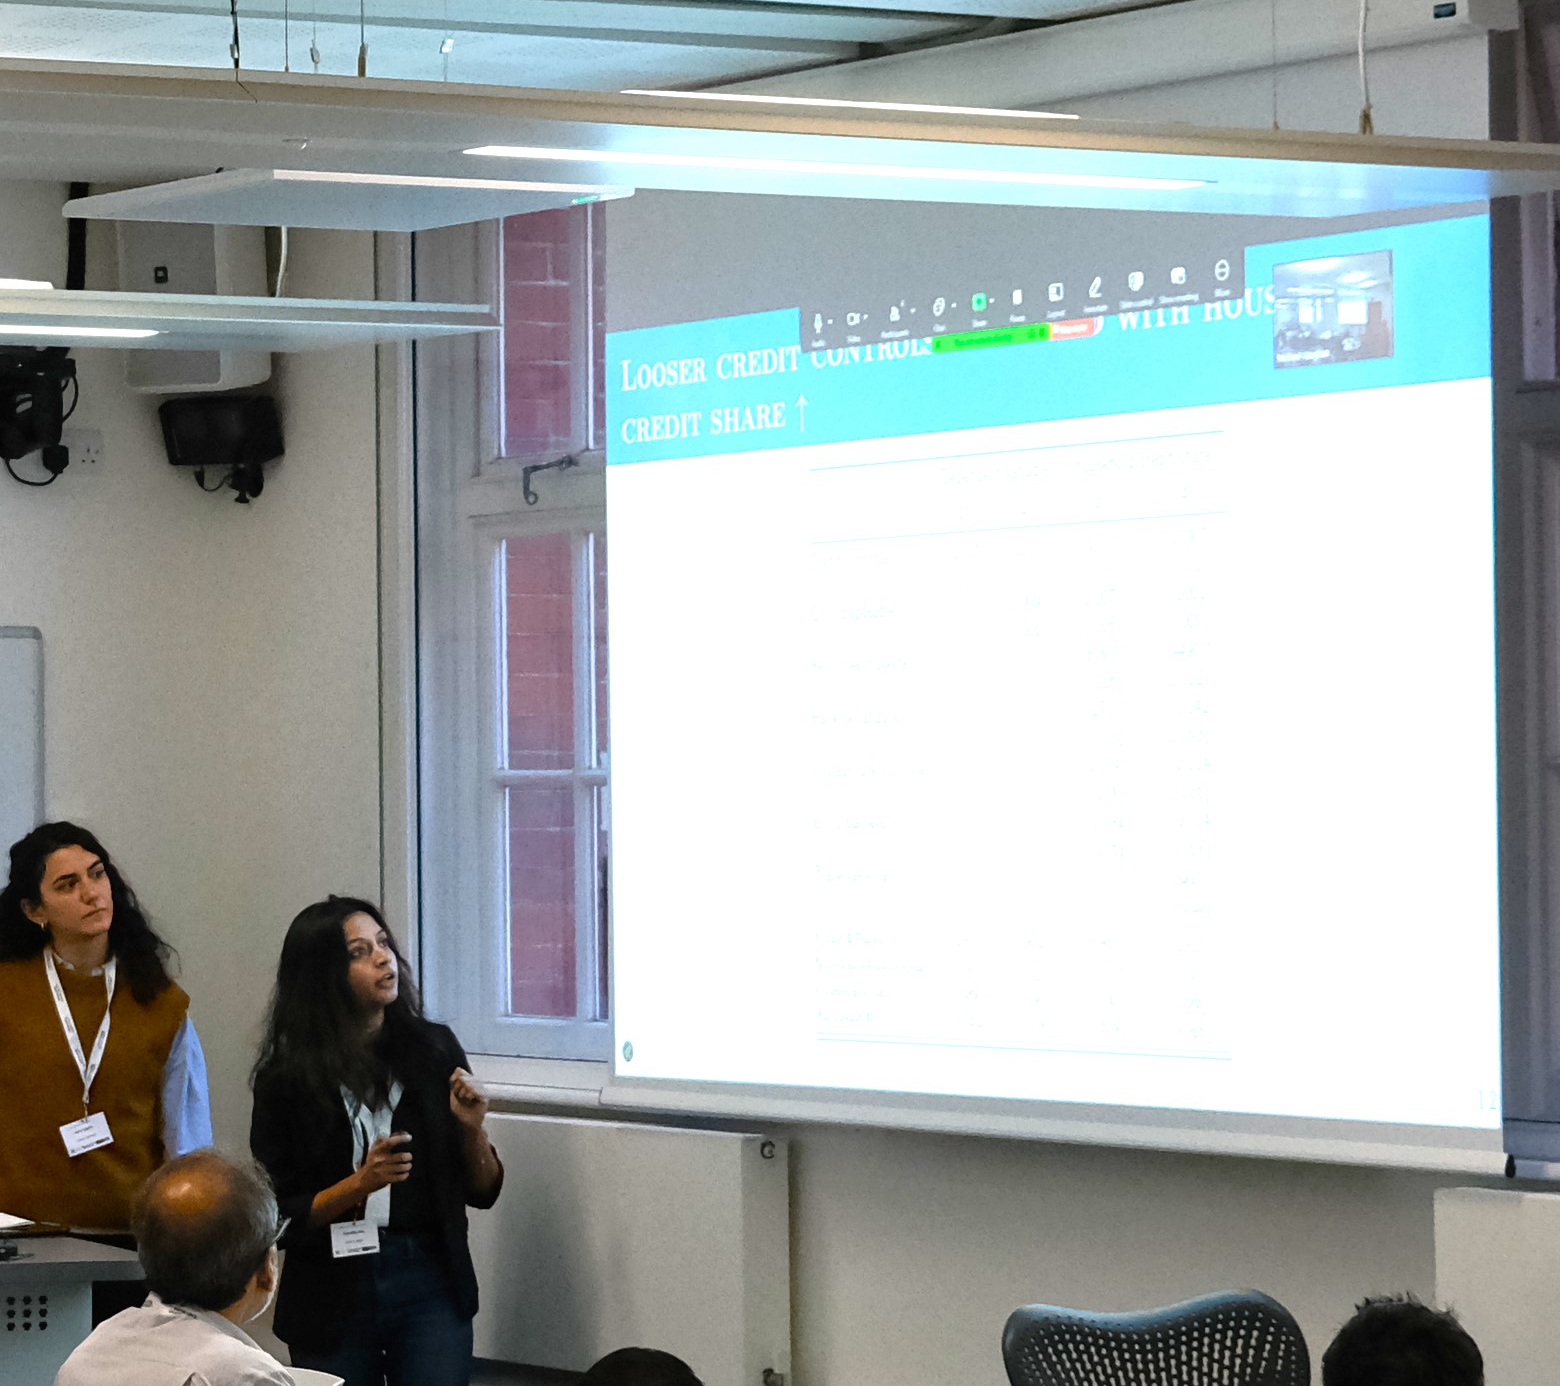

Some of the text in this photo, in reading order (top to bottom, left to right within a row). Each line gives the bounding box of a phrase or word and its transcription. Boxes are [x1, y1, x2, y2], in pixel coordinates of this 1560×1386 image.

[621, 357, 706, 391] LOOSER
[716, 344, 801, 379] CREDIT
[1119, 305, 1189, 331] WITH
[621, 401, 786, 444] CREDIT SHARE
